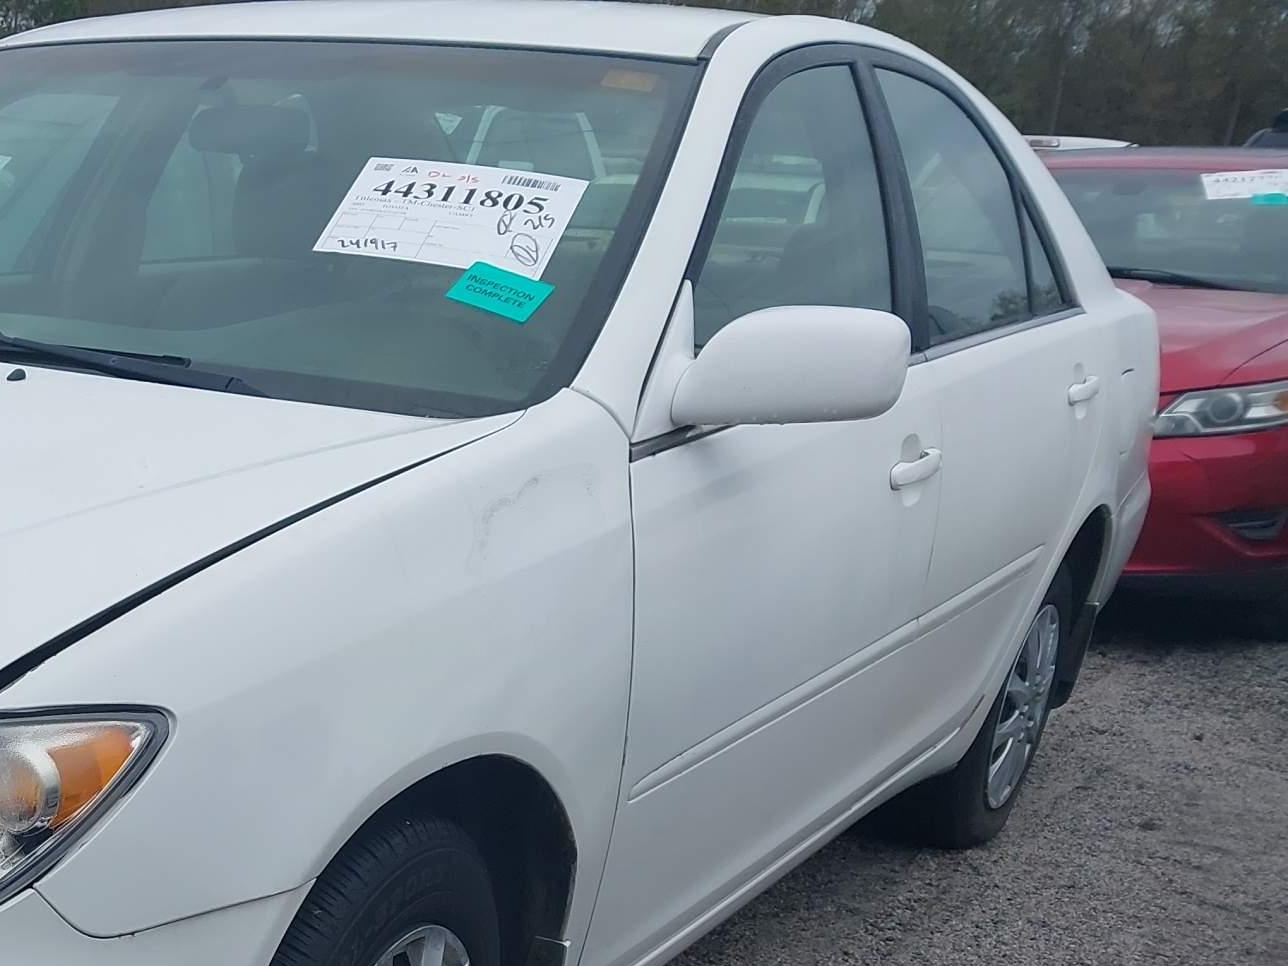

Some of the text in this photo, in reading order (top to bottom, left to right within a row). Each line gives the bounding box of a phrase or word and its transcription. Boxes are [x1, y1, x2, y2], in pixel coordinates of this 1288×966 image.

[373, 179, 550, 215] 44311805
[464, 283, 527, 308] COMPLETE
[467, 273, 536, 301] INSPECTION
